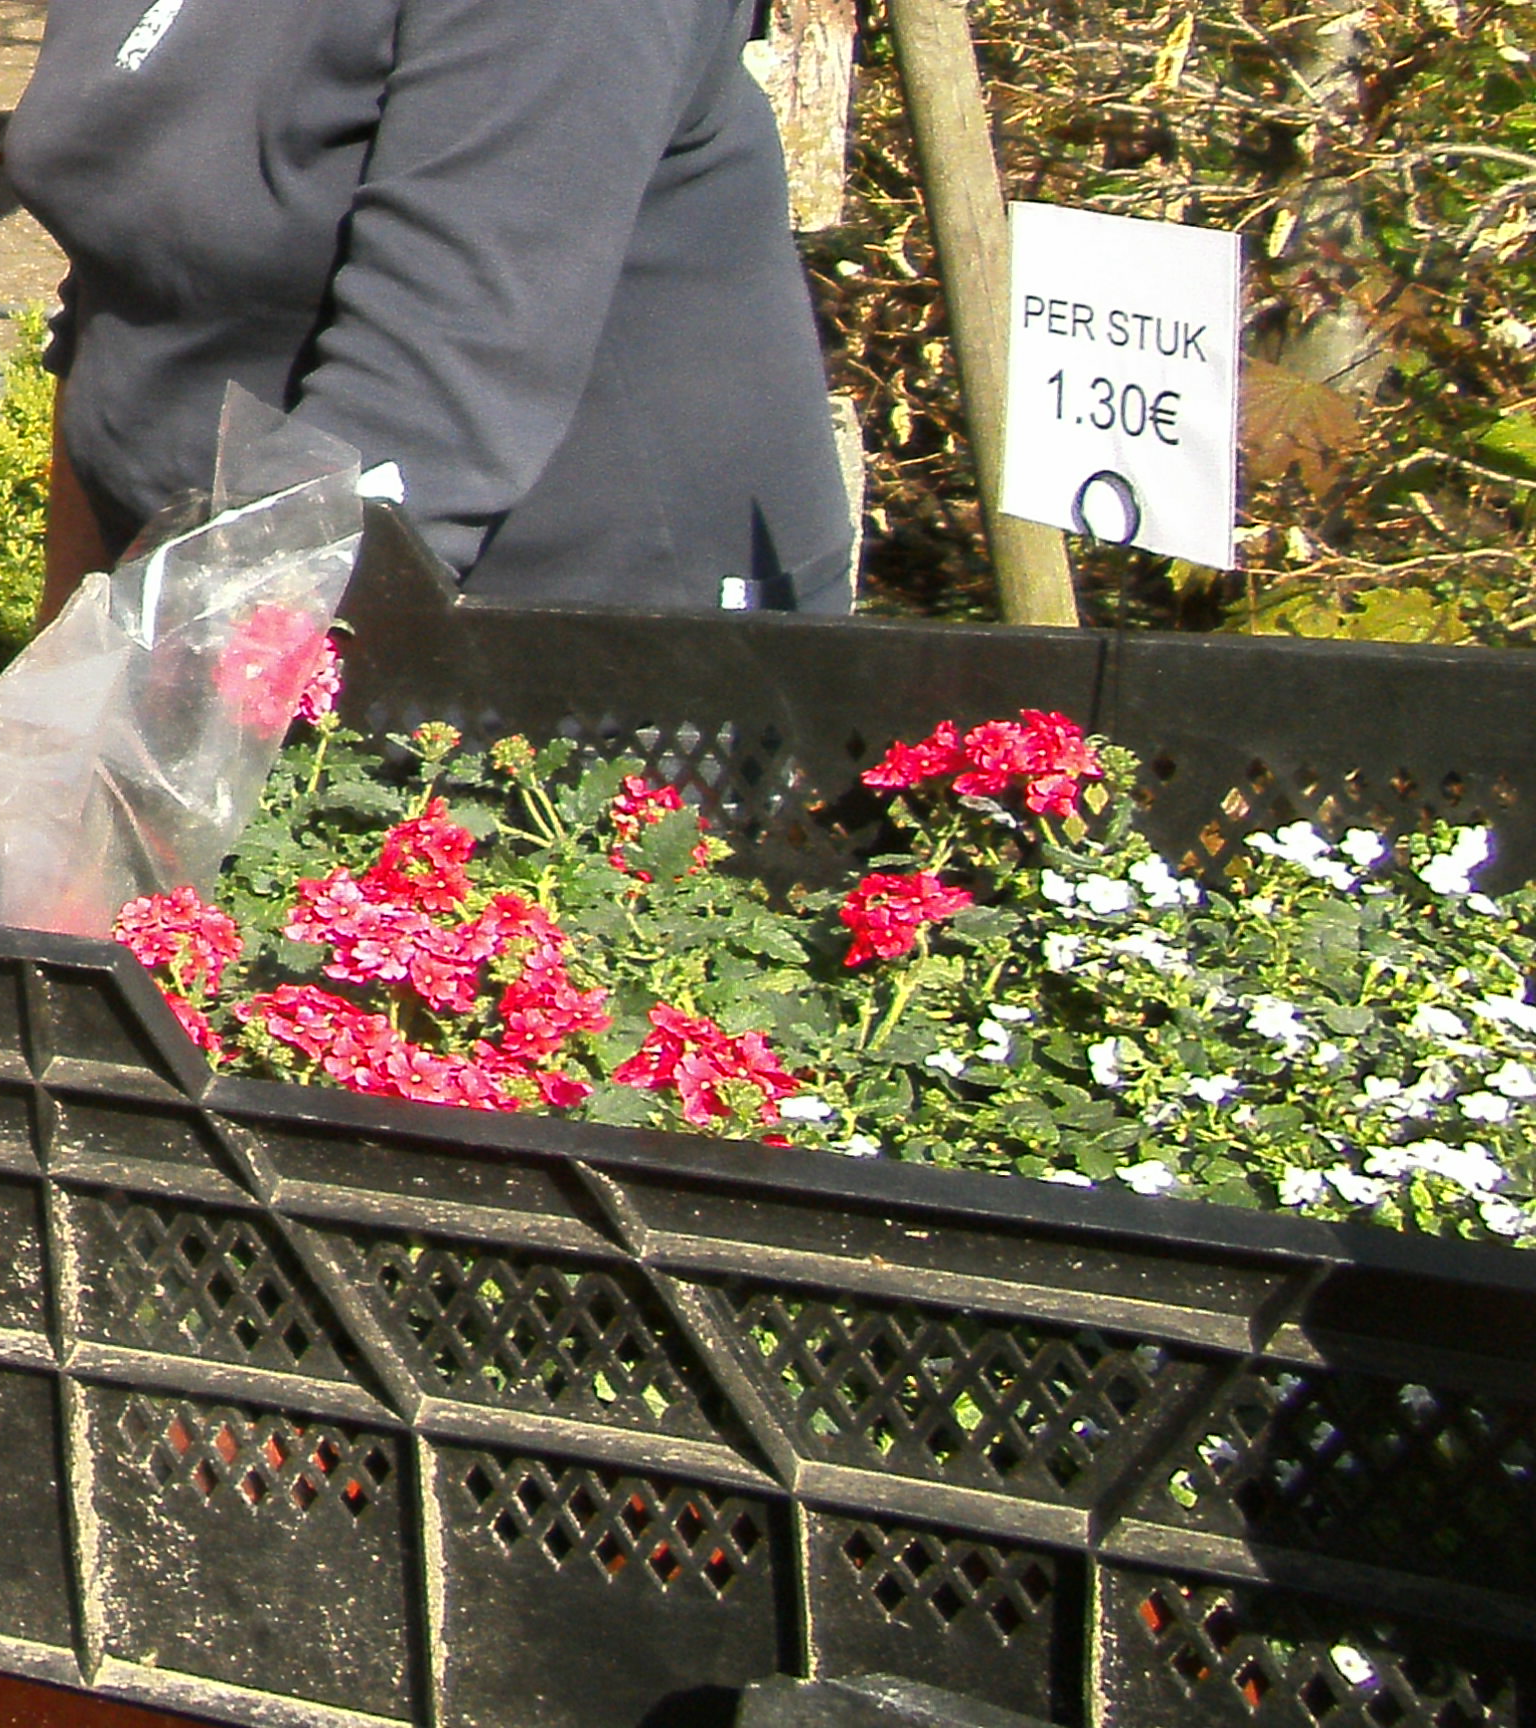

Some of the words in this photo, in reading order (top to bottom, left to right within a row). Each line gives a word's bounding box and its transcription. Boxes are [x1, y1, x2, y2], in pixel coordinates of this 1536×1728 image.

[1023, 294, 1095, 341] PER
[1106, 309, 1207, 363] STUK
[1047, 369, 1182, 446] 1.30€
